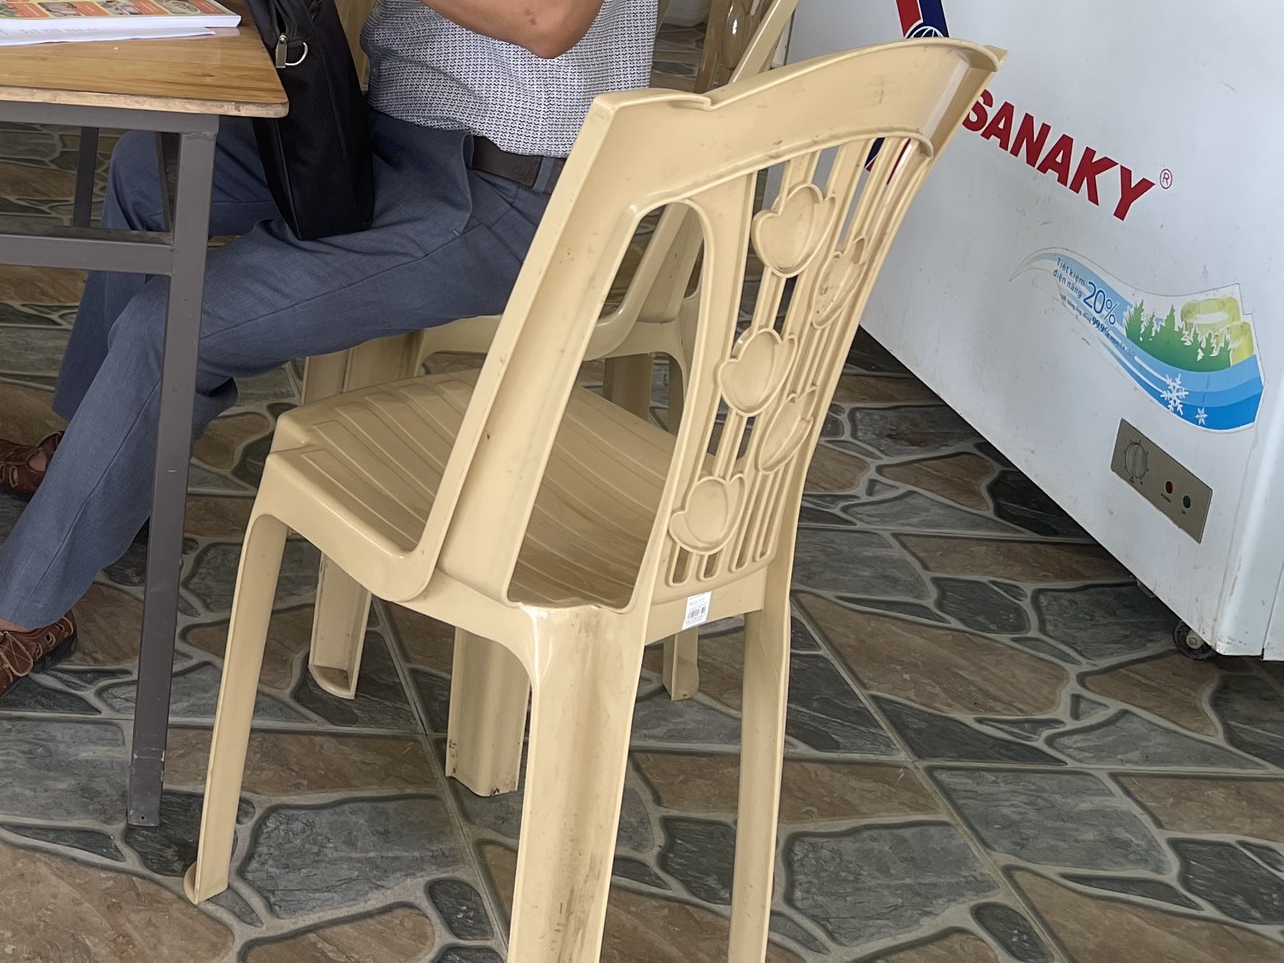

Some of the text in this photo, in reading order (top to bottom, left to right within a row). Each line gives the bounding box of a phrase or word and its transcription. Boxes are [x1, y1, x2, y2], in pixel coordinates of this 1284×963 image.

[962, 89, 1156, 221] SANAKY
[1052, 269, 1083, 299] điện năng
[1056, 257, 1086, 287] Tiết kiệm
[1083, 281, 1119, 325] 20%
